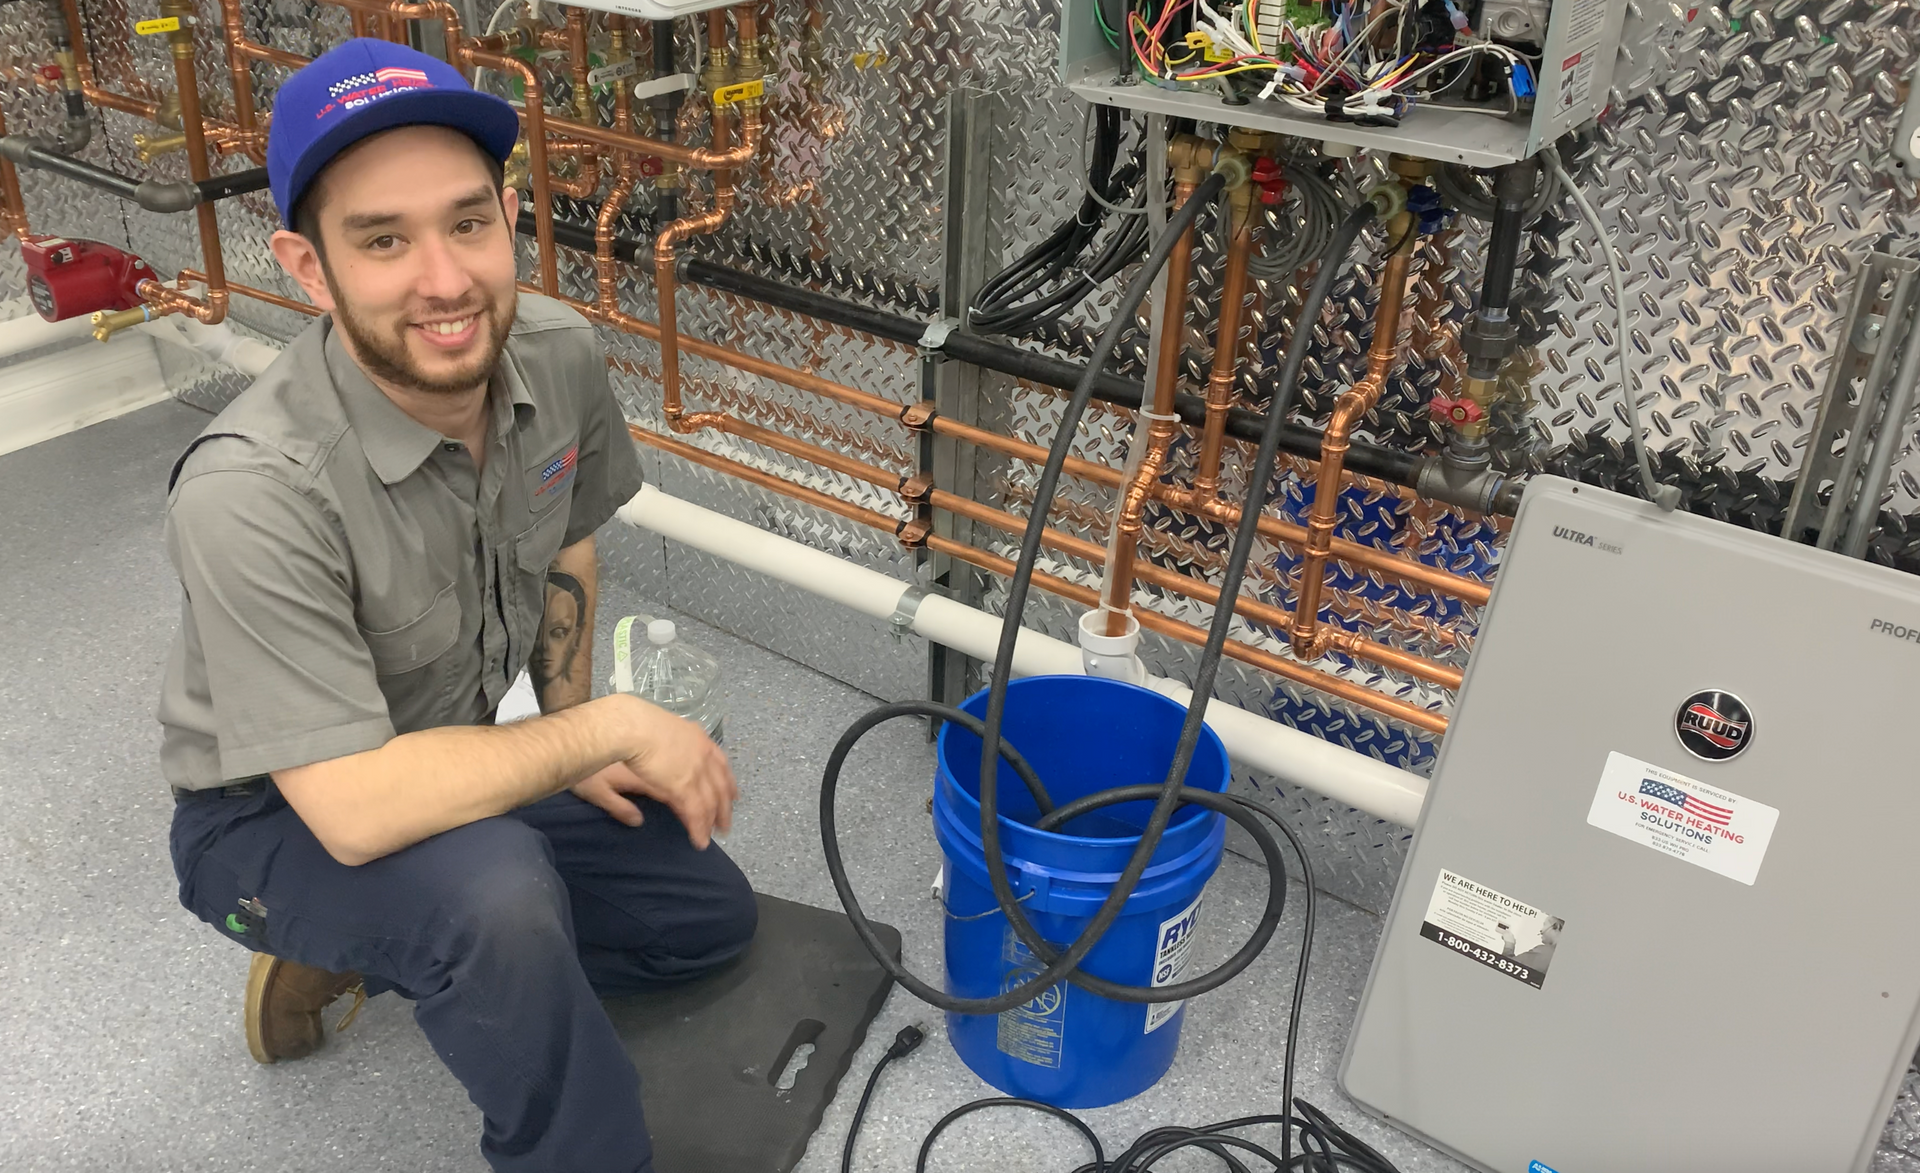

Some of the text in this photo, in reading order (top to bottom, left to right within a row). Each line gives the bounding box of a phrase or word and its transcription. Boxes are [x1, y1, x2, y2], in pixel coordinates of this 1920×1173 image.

[337, 85, 387, 104] WATER
[1553, 525, 1622, 555] ULTRA SERIES
[1683, 709, 1743, 741] RUUD
[1645, 767, 1658, 776] THIS
[1658, 772, 1691, 788] EQUIPMENT
[1699, 787, 1727, 801] SERVICED
[1617, 791, 1745, 844] U.S. WATER HEATING
[1640, 811, 1713, 845] SOLUTIONS
[1645, 826, 1675, 840] EMERGENCY
[1675, 837, 1696, 848] SERVICE
[1443, 872, 1538, 918] WE ARE HERE TO HELP!
[1438, 931, 1529, 980] 1-800-432-8373
[1158, 965, 1171, 980] NSF
